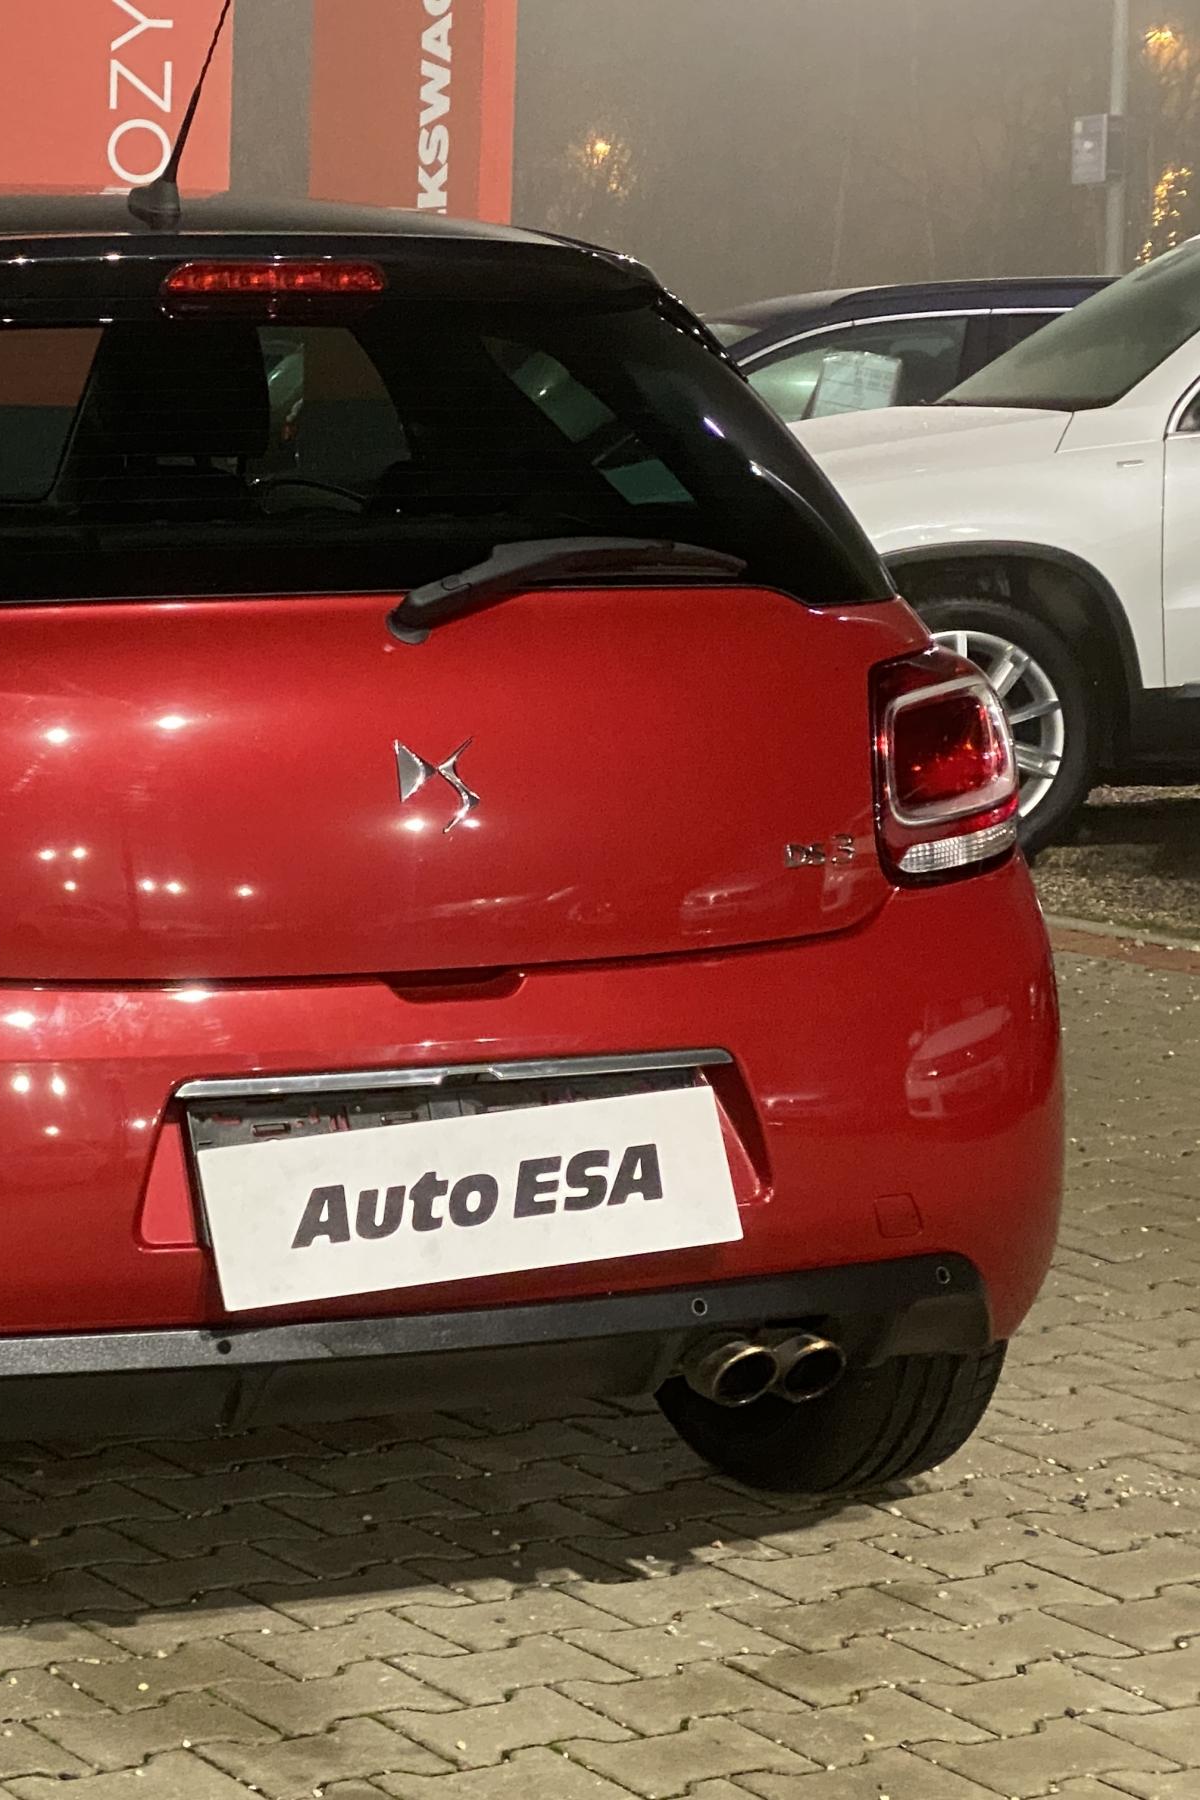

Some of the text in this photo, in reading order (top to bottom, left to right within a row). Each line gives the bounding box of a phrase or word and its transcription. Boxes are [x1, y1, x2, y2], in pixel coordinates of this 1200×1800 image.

[106, 0, 174, 196] OZY
[417, 0, 453, 214] KSWA
[291, 1143, 663, 1249] Auto ESA
